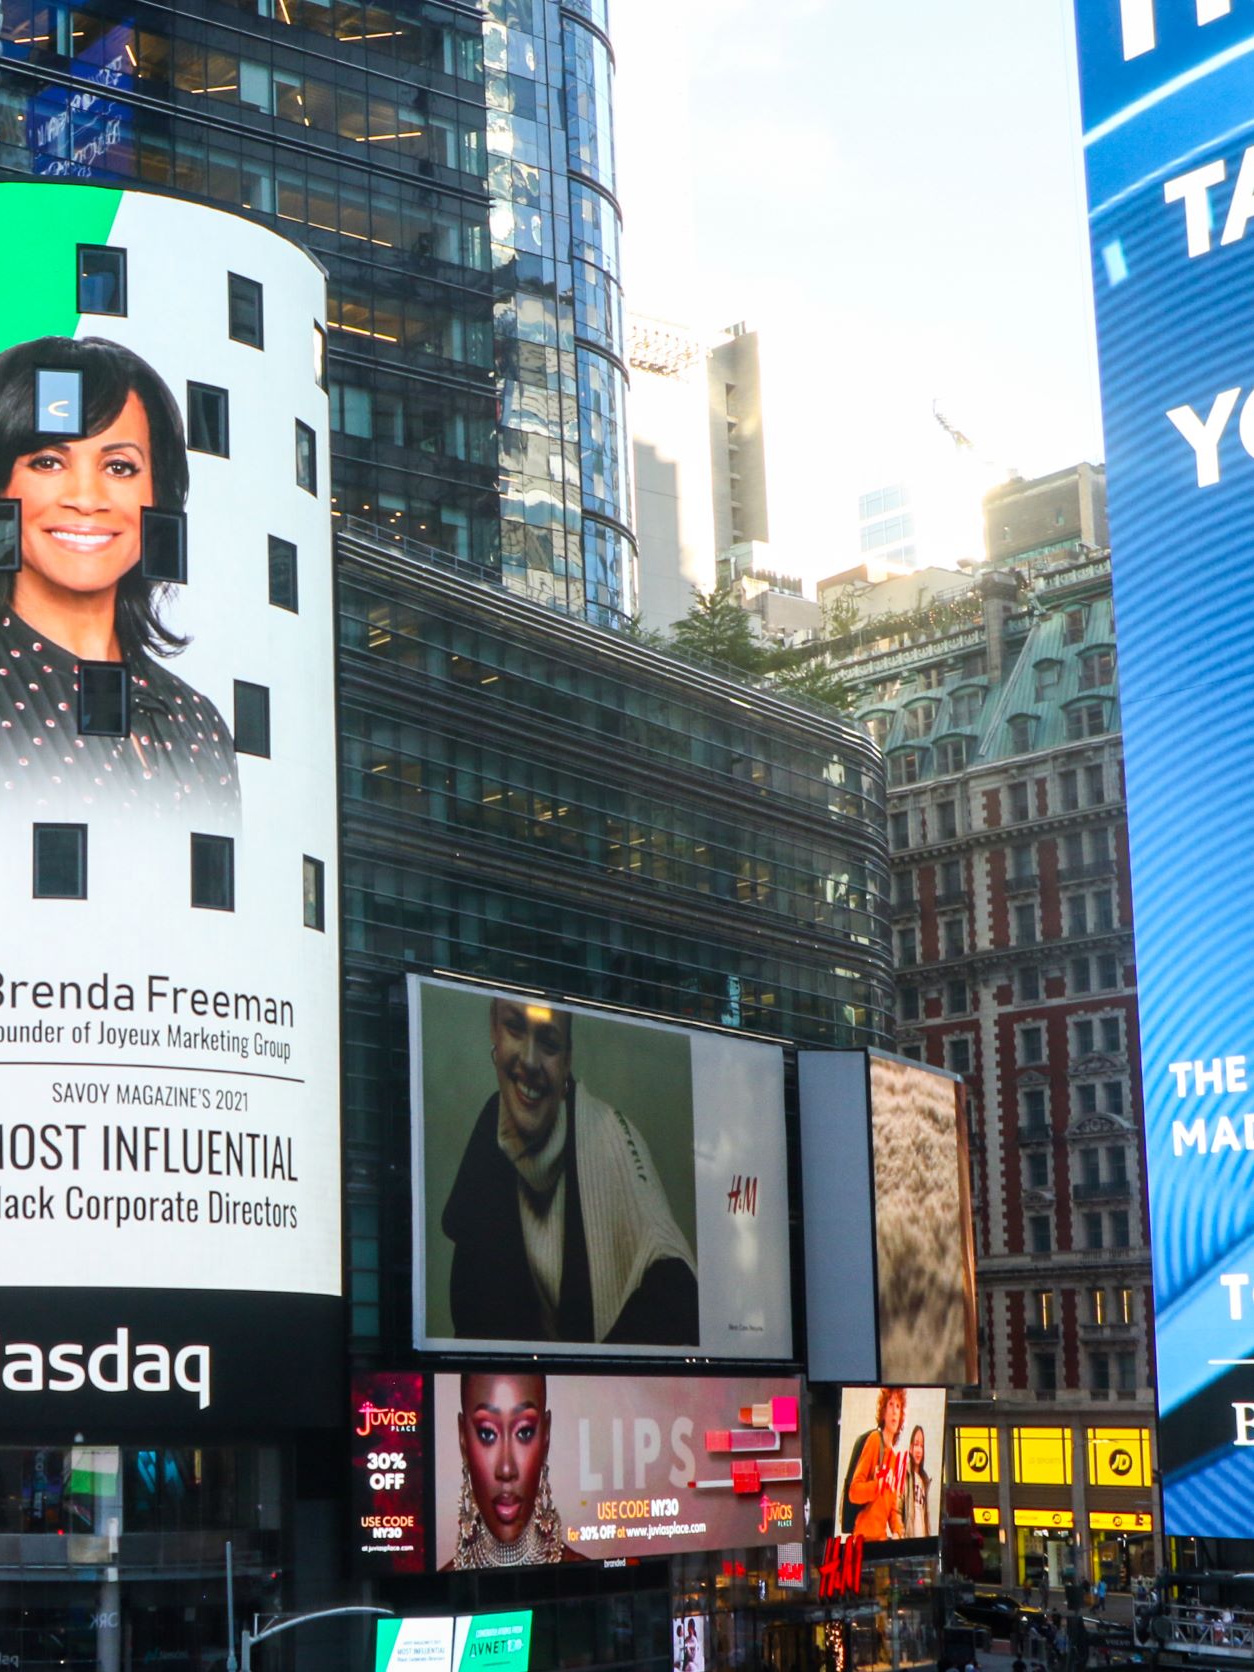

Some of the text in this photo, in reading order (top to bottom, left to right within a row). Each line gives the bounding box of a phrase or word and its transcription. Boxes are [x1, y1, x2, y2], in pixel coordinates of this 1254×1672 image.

[148, 974, 294, 1028] Freeman
[72, 1021, 91, 1044] of
[98, 1021, 161, 1049] Joyeux
[167, 1024, 249, 1059] Marketing
[254, 1032, 291, 1065] Group
[1169, 1055, 1248, 1098] THE
[52, 1082, 249, 1112] SAVOY MAGAZINE'S 2021
[102, 1125, 298, 1182] INFLUENTIAL
[66, 1186, 199, 1228] Corporate
[209, 1190, 298, 1230] Directors
[1220, 1273, 1254, 1320] T
[367, 1452, 407, 1470] 30%
[579, 1416, 697, 1492] LIPS
[968, 1449, 987, 1469] JD
[1111, 1450, 1131, 1472] JD
[369, 1473, 405, 1490] OFF
[361, 1516, 414, 1527] USE CODE
[597, 1498, 679, 1520] USE CODE NY30
[372, 1527, 403, 1539] NY30
[568, 1521, 706, 1542] for 30% OFF at www.juviasplace.com
